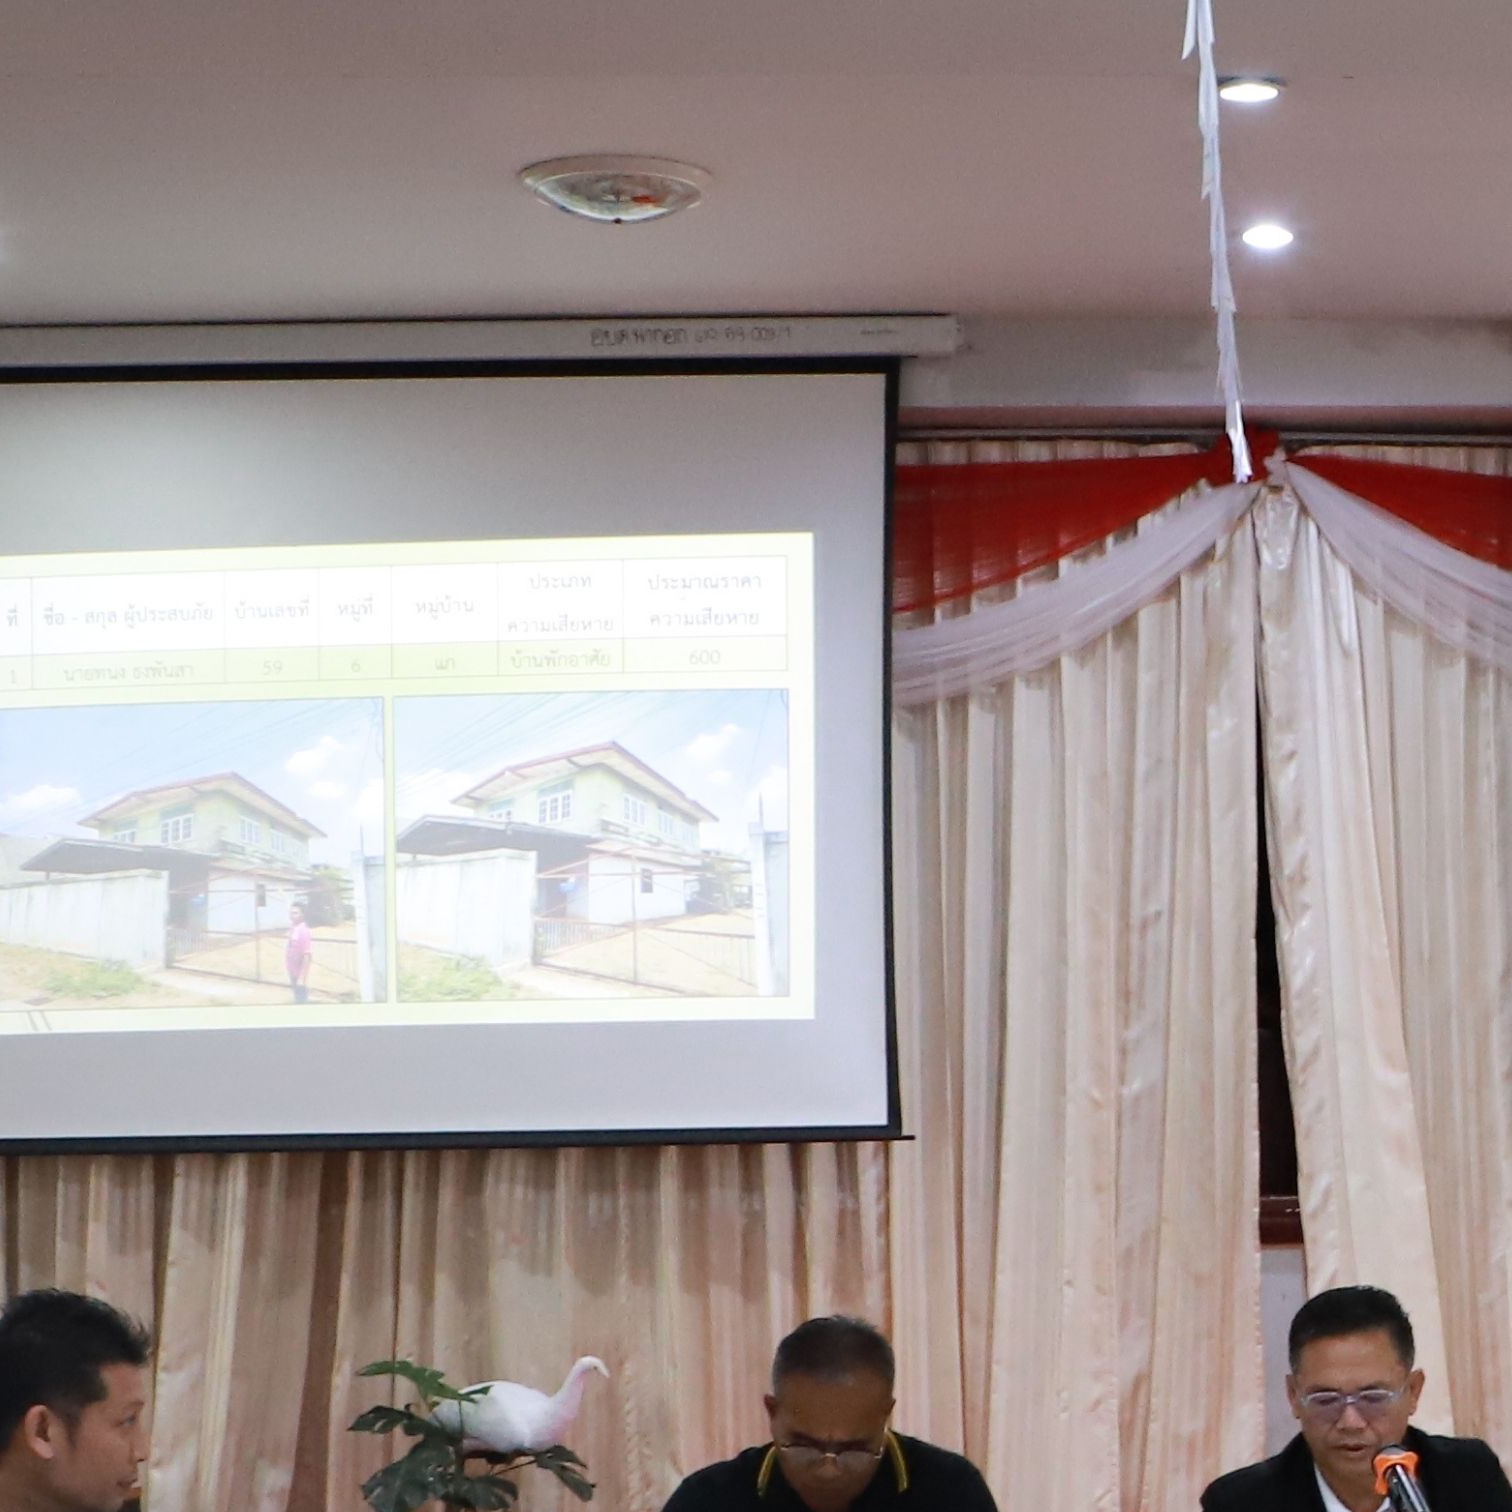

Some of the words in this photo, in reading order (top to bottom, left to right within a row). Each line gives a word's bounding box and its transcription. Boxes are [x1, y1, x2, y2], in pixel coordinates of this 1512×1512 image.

[648, 573, 762, 591] ประมาณราคา
[688, 649, 721, 665] 600
[263, 660, 283, 675] 59
